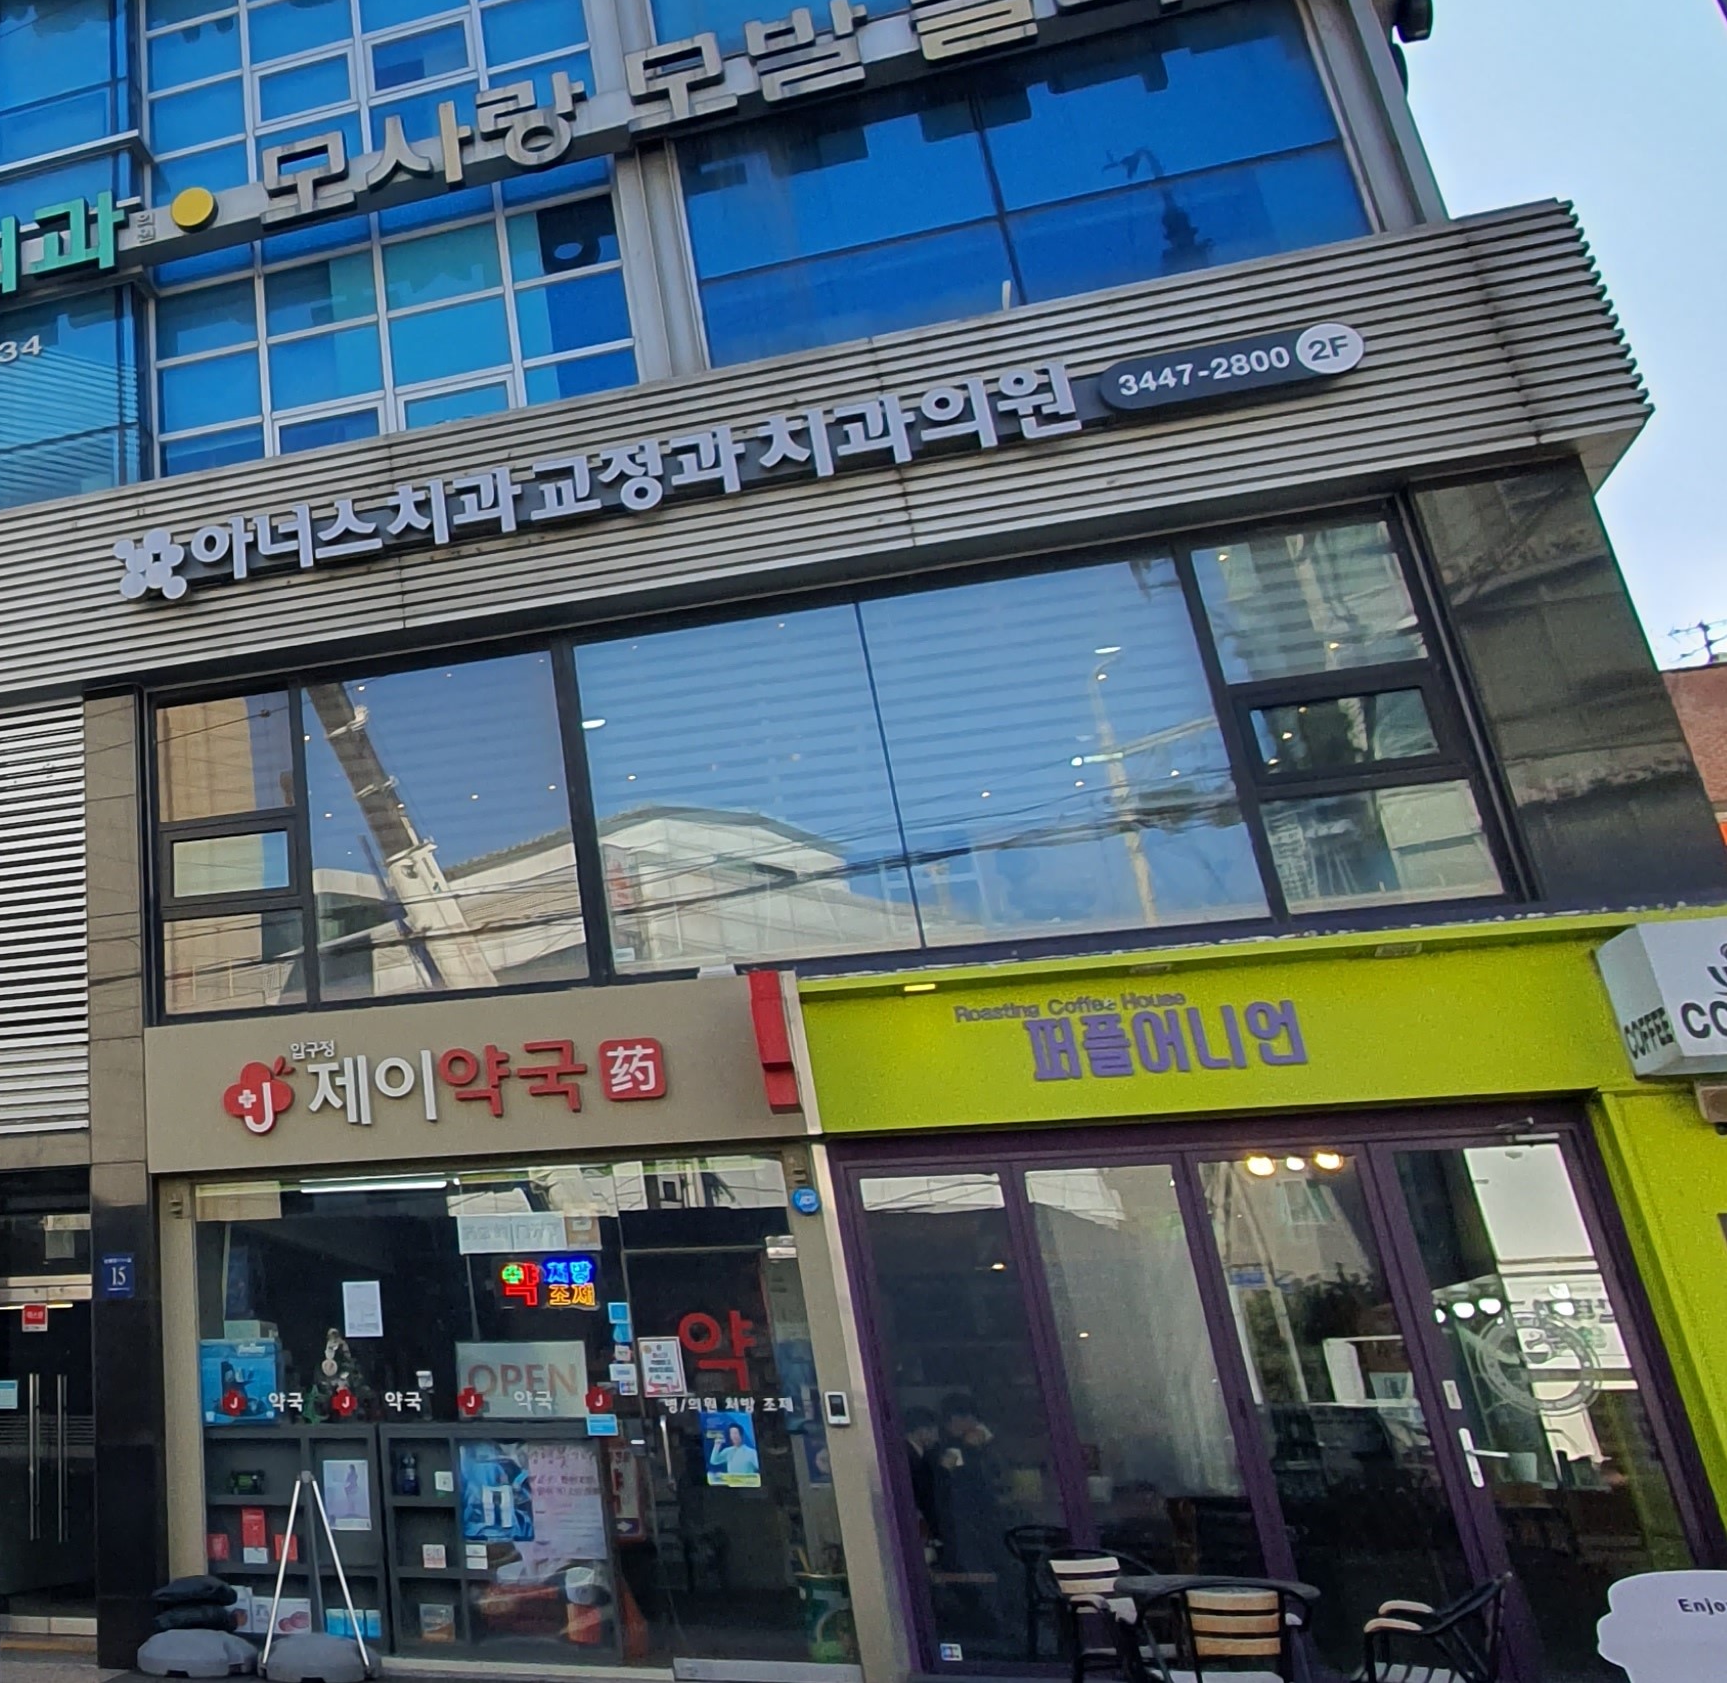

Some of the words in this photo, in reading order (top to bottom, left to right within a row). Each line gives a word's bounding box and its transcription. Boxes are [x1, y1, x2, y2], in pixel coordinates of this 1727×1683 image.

[262, 72, 586, 220] 모사랑
[1118, 346, 1290, 399] 3447-2800
[1307, 334, 1352, 361] 2F
[953, 1002, 1041, 1024] Roasting
[1121, 991, 1188, 1011] House
[290, 1040, 336, 1061] 압구정
[1024, 998, 1309, 1083] 퍼플어니언
[308, 1038, 588, 1126] 제이약국
[111, 1265, 127, 1287] 15
[548, 1284, 596, 1307] 조제
[678, 1309, 758, 1393] 약
[467, 1362, 579, 1399] OPEN
[268, 1390, 305, 1413] 약국
[384, 1390, 423, 1413] 약국
[513, 1390, 554, 1412] 약국
[1677, 1597, 1727, 1616] Enjo
